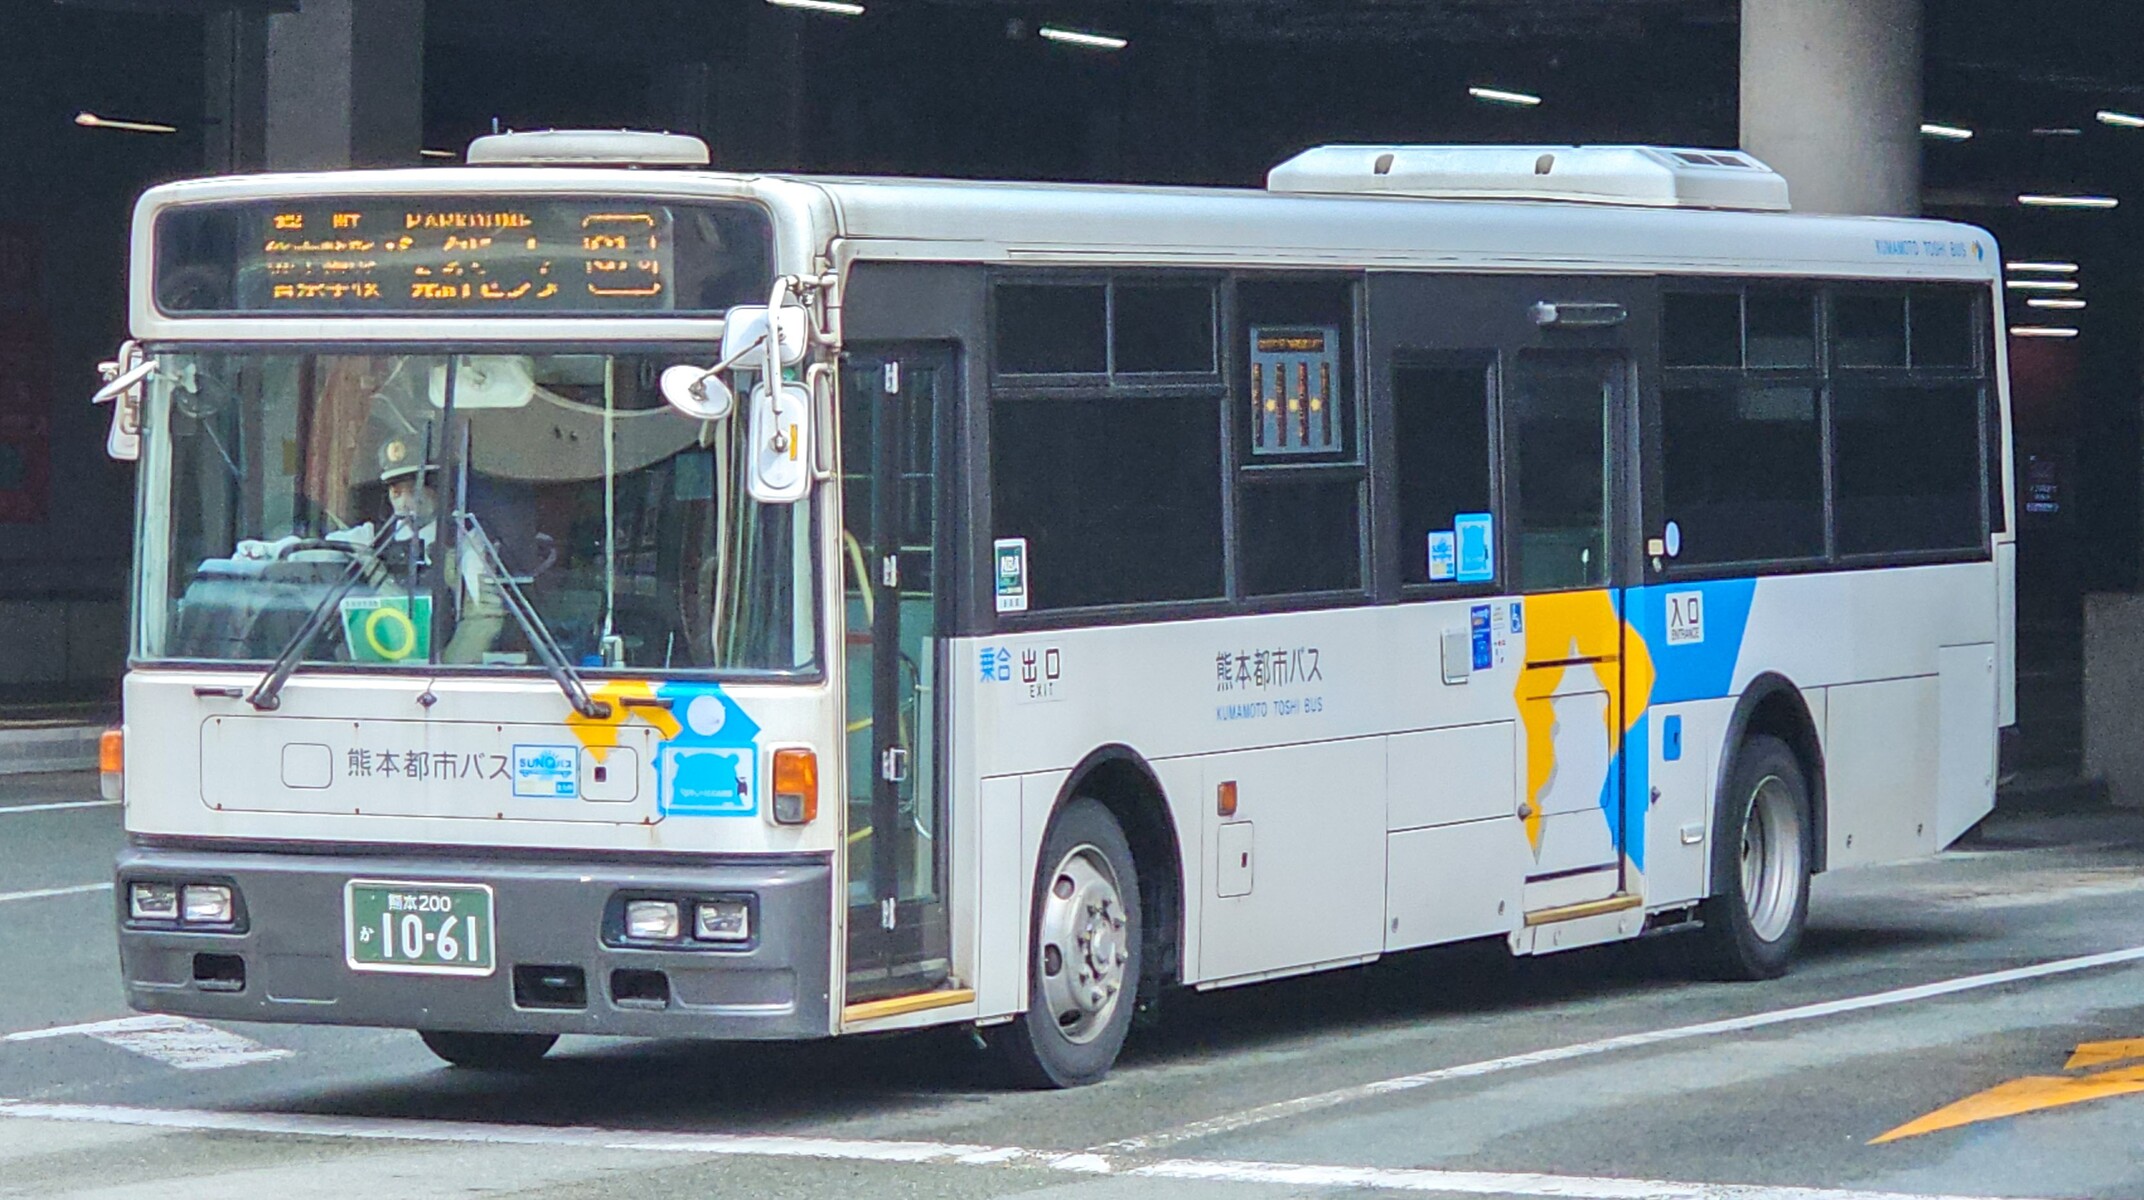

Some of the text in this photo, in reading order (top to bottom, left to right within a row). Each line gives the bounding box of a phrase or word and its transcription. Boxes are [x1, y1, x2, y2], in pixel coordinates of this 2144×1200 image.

[1949, 241, 1967, 257] BUS
[1671, 597, 1699, 628] 入口
[1671, 627, 1700, 641] ENTRANCE
[980, 647, 1011, 682] 乗合
[1022, 647, 1061, 683] 出口
[1216, 647, 1322, 691] 熊本都市バス
[1029, 682, 1054, 698] EXIT
[1216, 696, 1323, 720] KUMAMOTO TOSHI BUS
[347, 747, 512, 782] 熊本都市バス
[360, 912, 478, 962] か 10-61
